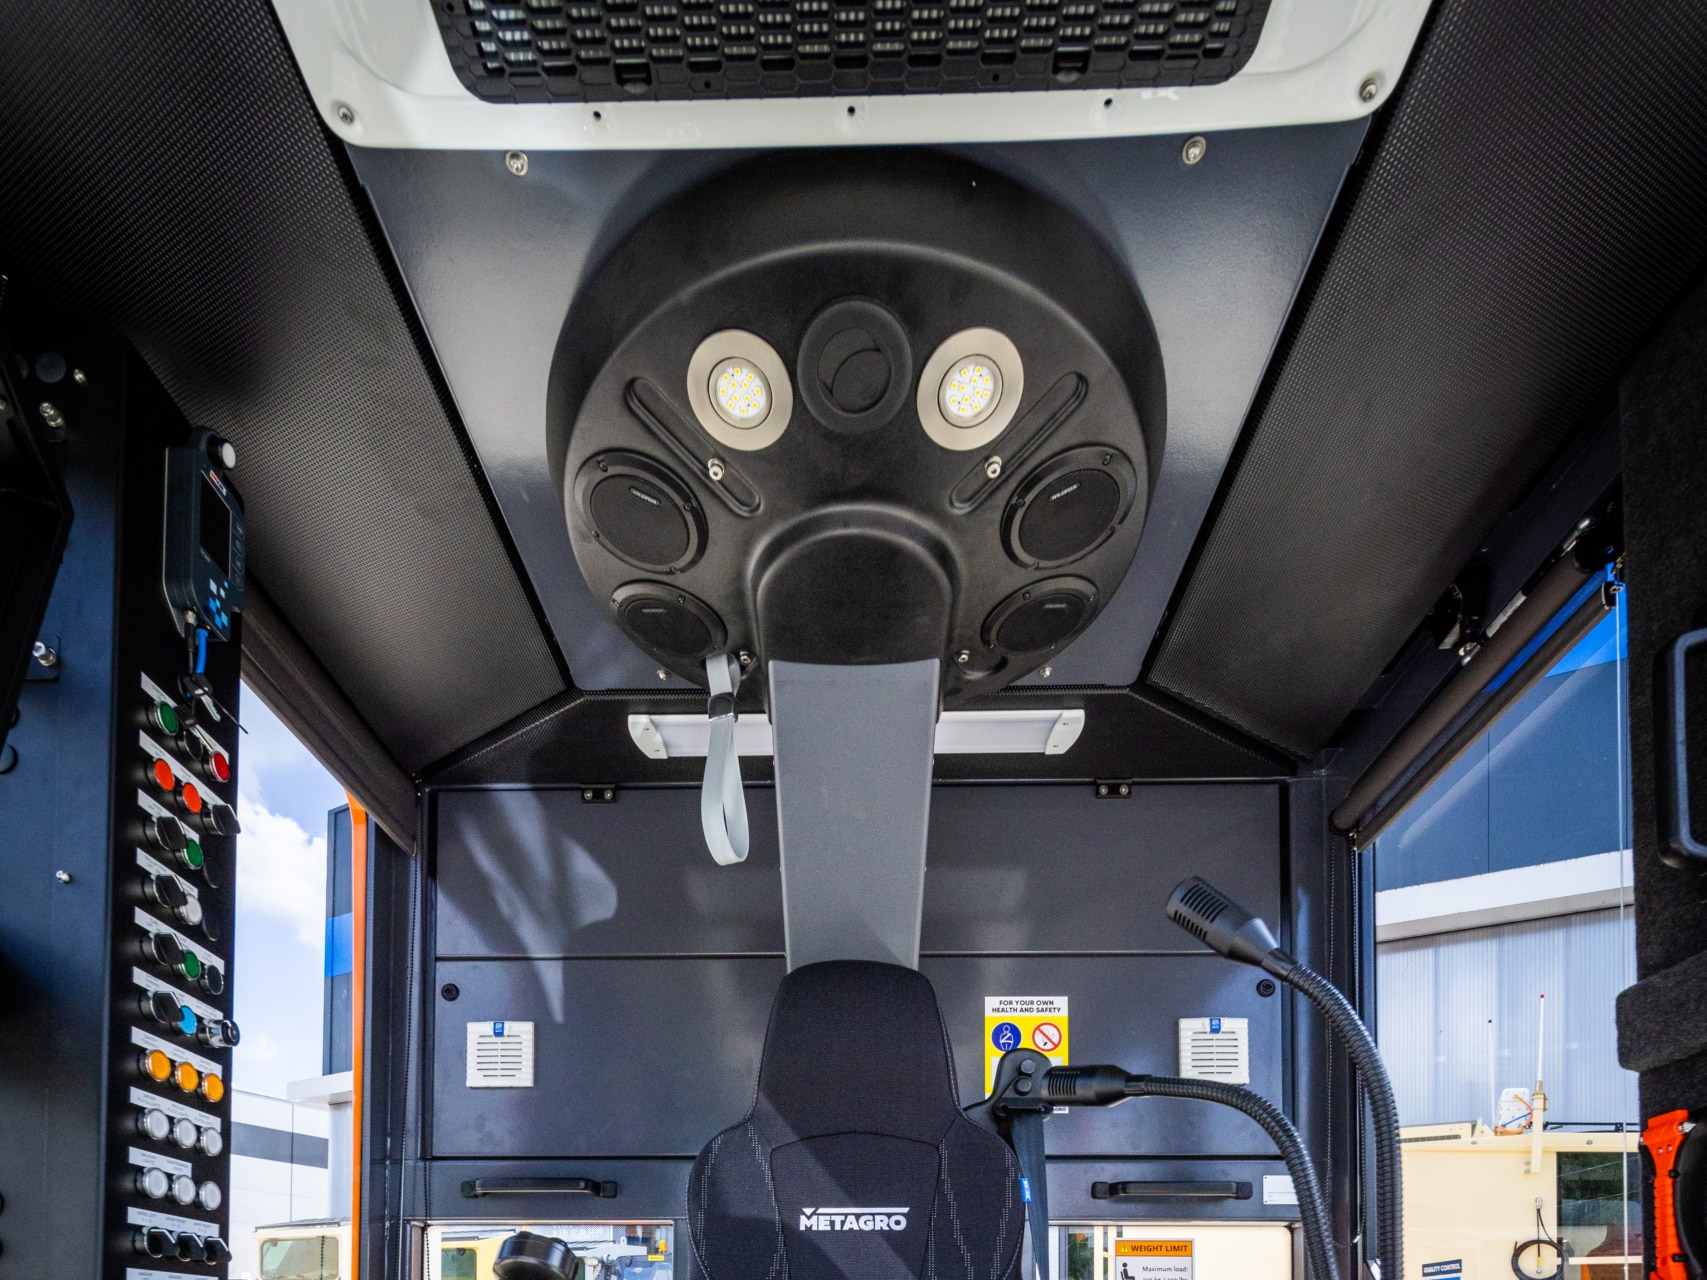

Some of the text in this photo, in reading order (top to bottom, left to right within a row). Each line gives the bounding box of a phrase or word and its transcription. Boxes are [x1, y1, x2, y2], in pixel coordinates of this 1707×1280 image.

[799, 1214, 907, 1231] METAGRO
[1130, 1244, 1188, 1252] WEIGHT LIMIT
[1424, 1263, 1461, 1273] QUALITY CONTROL
